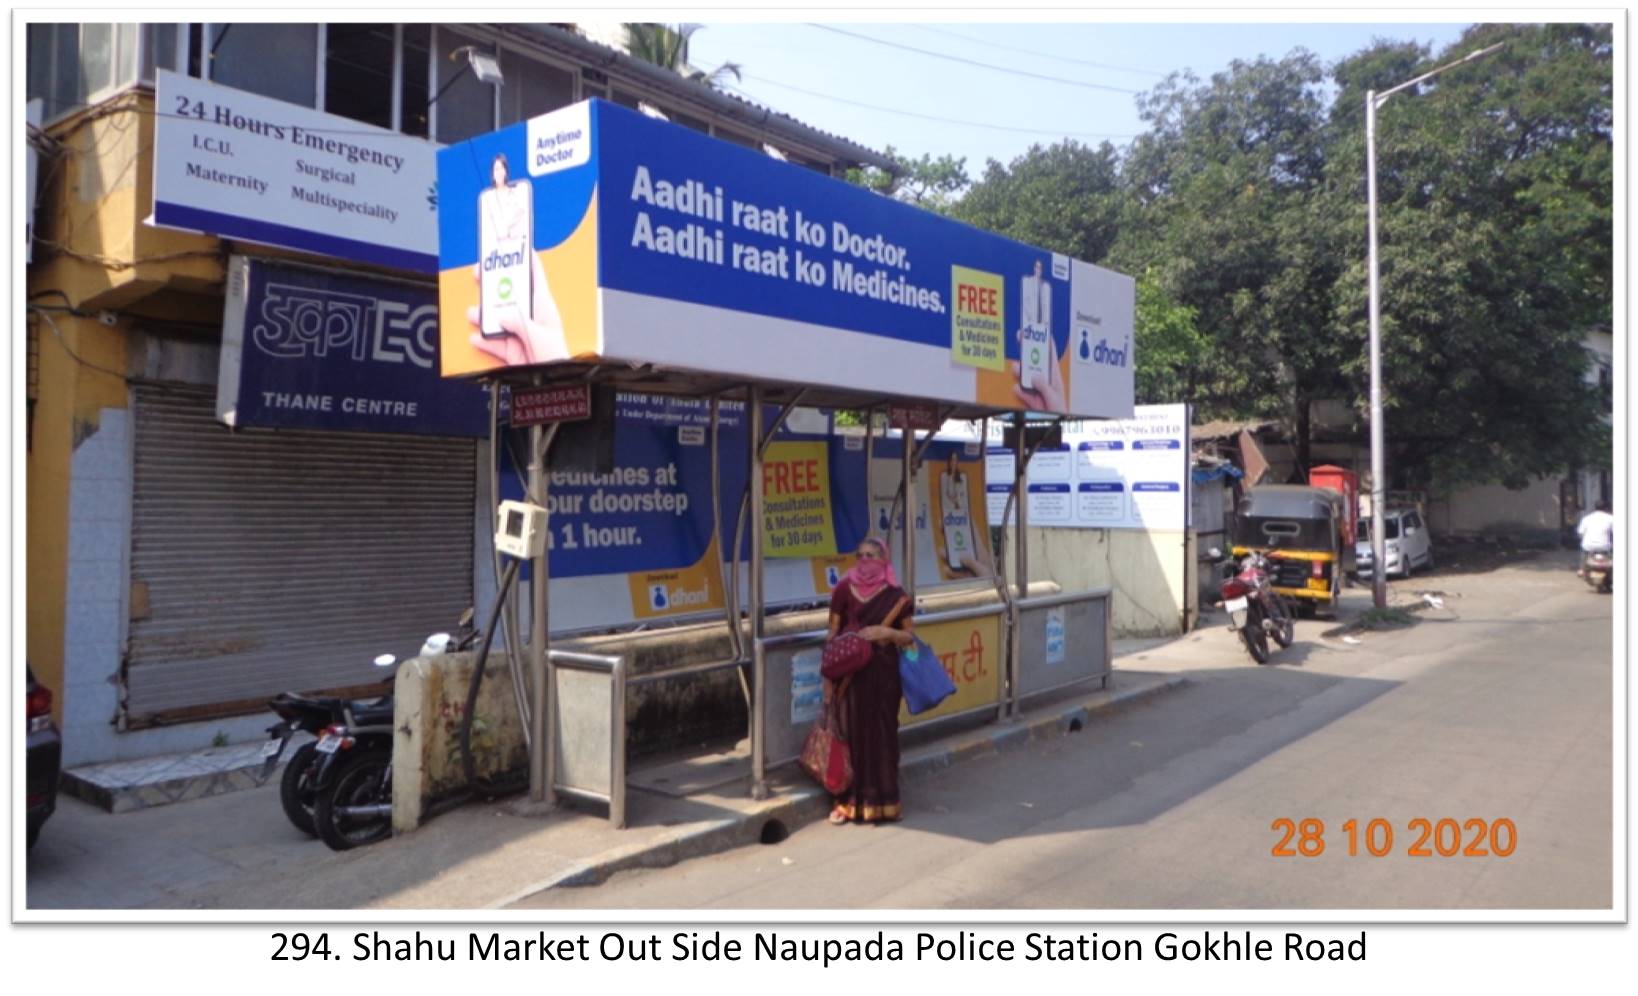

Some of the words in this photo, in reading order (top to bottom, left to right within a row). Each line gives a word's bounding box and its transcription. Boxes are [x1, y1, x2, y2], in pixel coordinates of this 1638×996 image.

[174, 94, 207, 120] 24
[214, 105, 285, 140] Hours
[291, 126, 405, 174] Emergency
[192, 134, 235, 157] I.C.U.
[536, 129, 582, 150] Anytime
[295, 159, 356, 186] Surgical
[536, 148, 574, 167] Doctor
[185, 161, 269, 194] Maternity
[291, 185, 399, 223] Multispeciality
[631, 165, 724, 223] Aadhi
[732, 200, 789, 240] raat
[795, 210, 827, 249] ko
[832, 221, 912, 272] Doctor.
[483, 235, 527, 272] dhani
[631, 212, 724, 266] Aadhi
[732, 242, 789, 281] raat
[795, 250, 827, 287] ko
[832, 259, 946, 314] Medicines.
[957, 283, 999, 317] FREE
[1023, 323, 1048, 344] dhani
[1092, 334, 1130, 368] dhani
[262, 391, 335, 413] THANE
[341, 397, 419, 417] CENTRE
[654, 461, 678, 486] at
[762, 458, 821, 497] FREE
[588, 488, 689, 516] doorstep
[561, 522, 579, 550] 1
[582, 520, 642, 548] hour.
[765, 517, 774, 531] &
[775, 513, 825, 529] Medicines
[770, 533, 785, 549] for
[787, 532, 800, 546] 30
[801, 530, 824, 545] days
[670, 577, 711, 607] dhani
[939, 630, 988, 683] स.टी.
